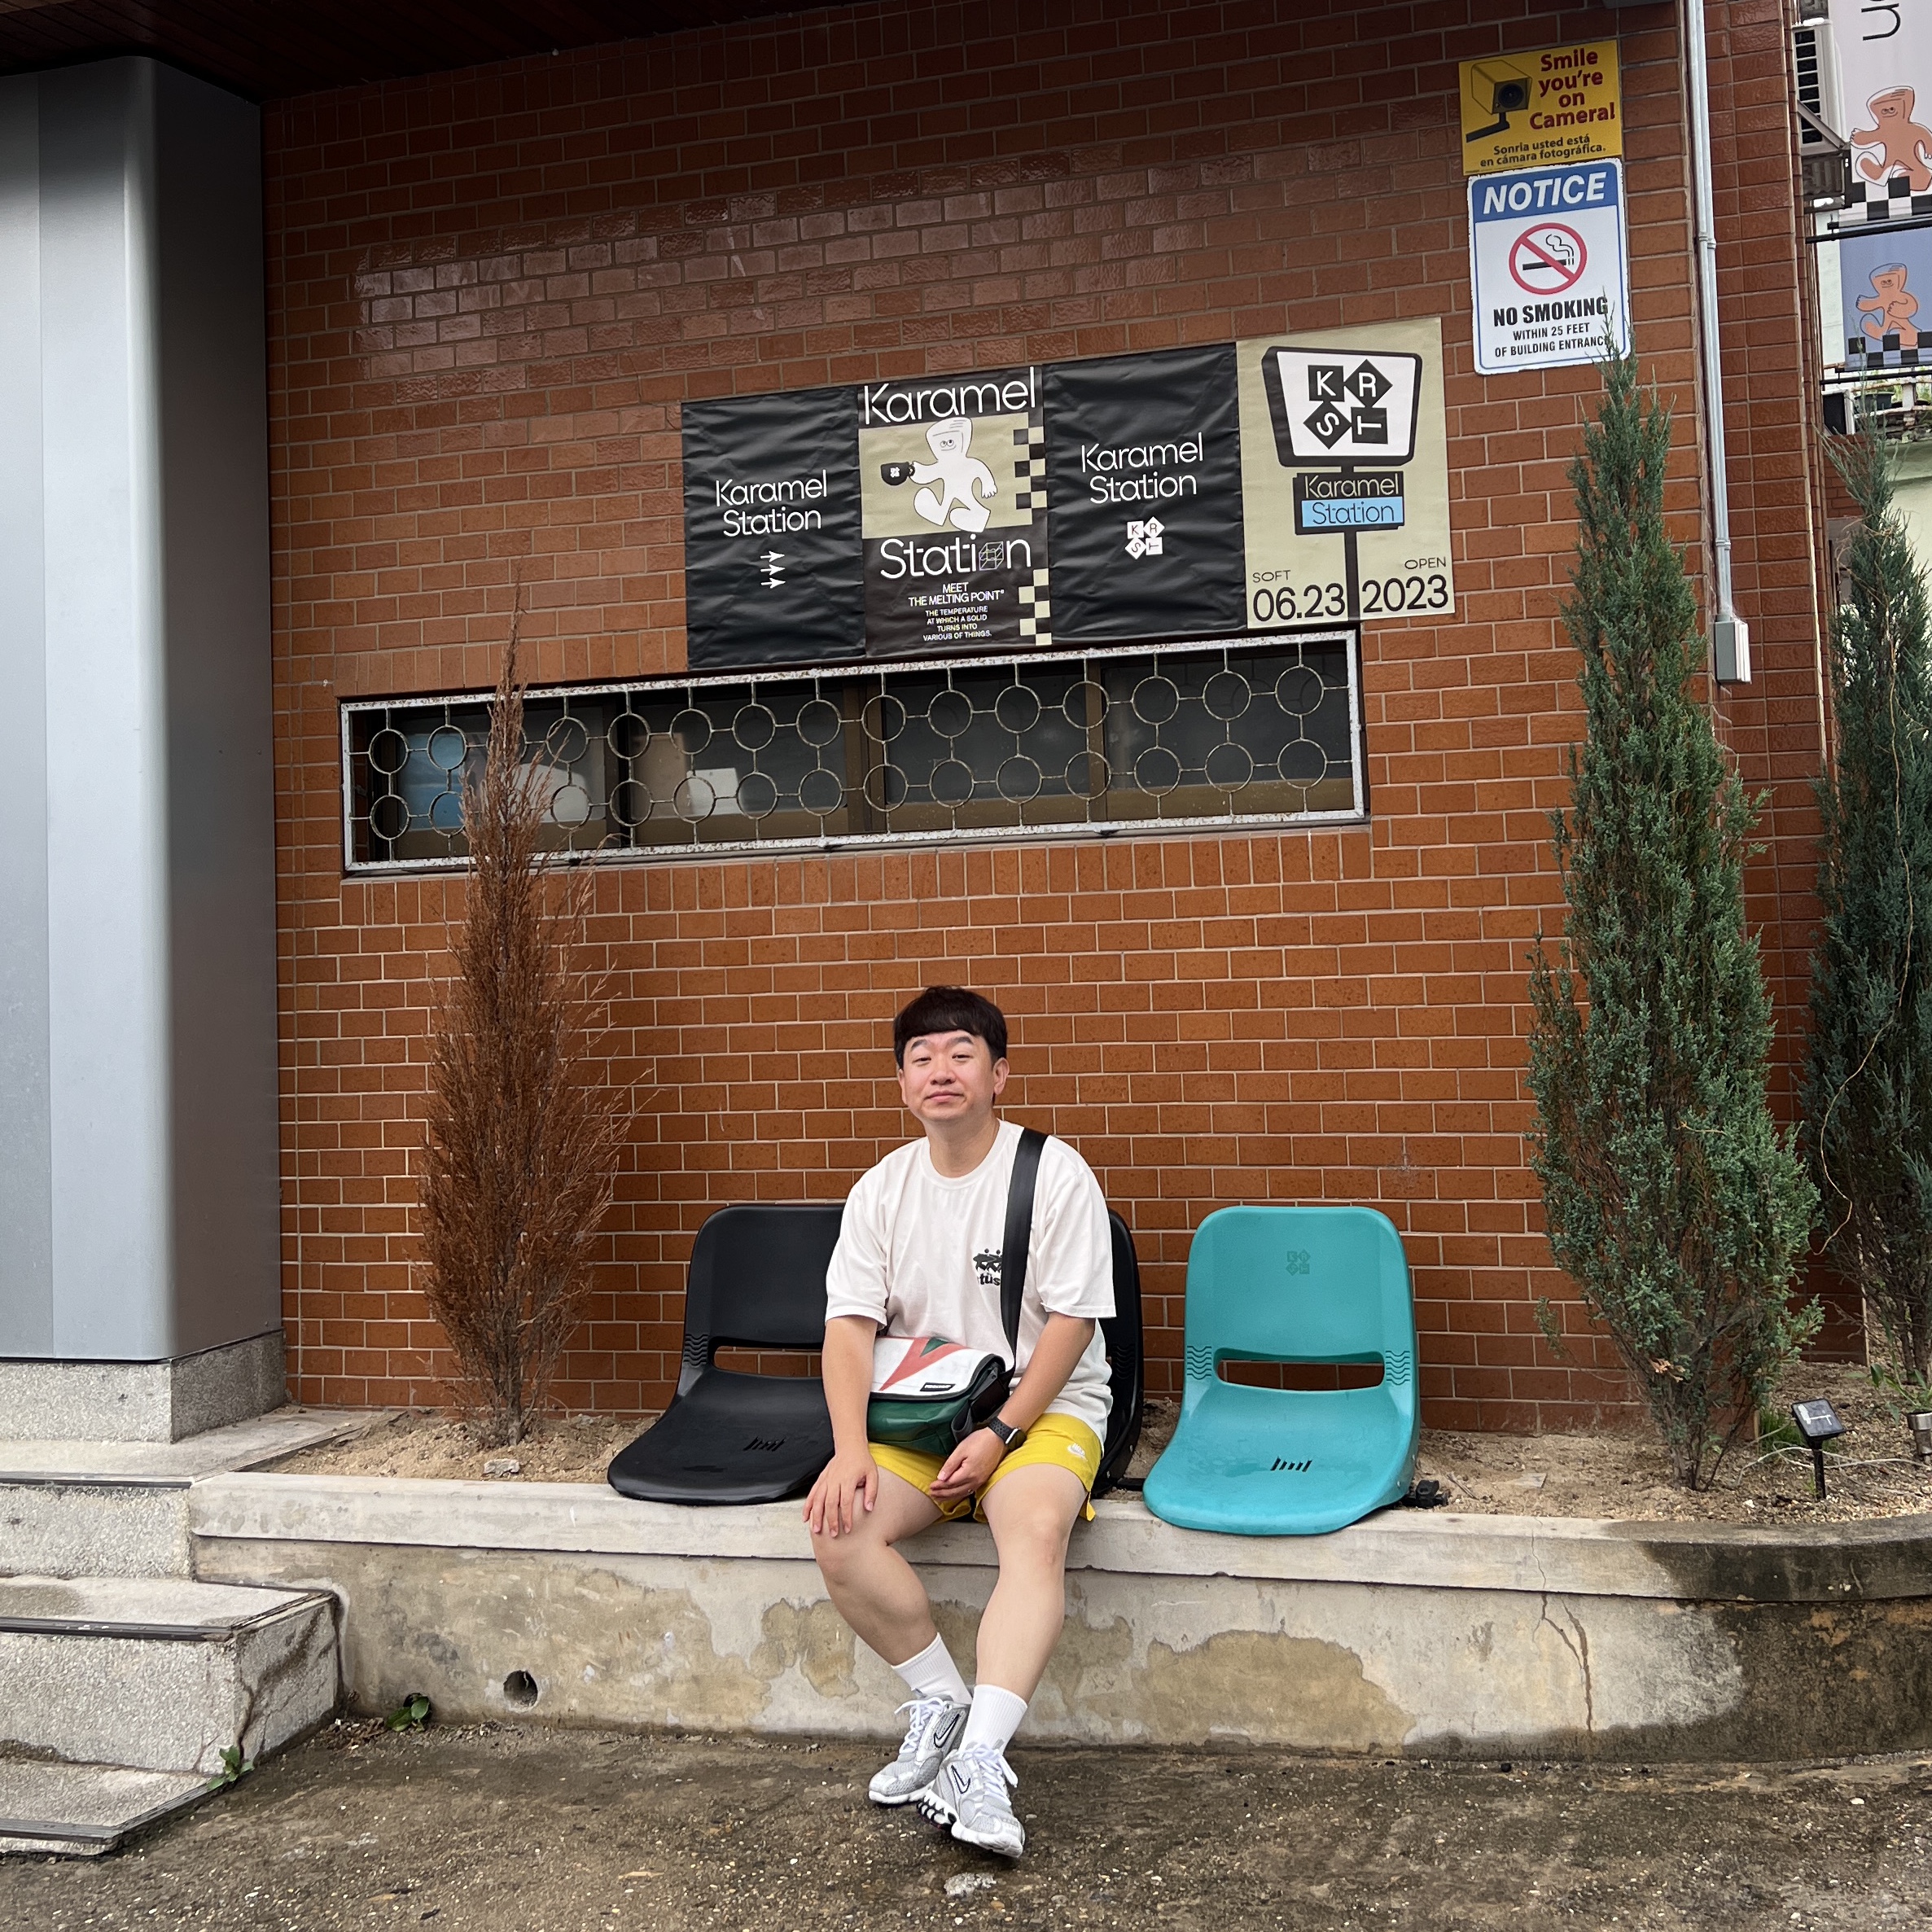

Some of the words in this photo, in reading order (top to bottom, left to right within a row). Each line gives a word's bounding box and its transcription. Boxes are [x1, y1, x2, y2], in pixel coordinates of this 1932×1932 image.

[1540, 47, 1598, 72] Smile
[1538, 70, 1603, 98] you're
[1558, 91, 1585, 107] on
[1532, 137, 1563, 151] usted
[1566, 133, 1590, 146] está
[1480, 157, 1494, 167] en
[1496, 151, 1537, 164] cámara
[1540, 142, 1606, 160] fotográfica.
[1483, 171, 1607, 215] NOTICE
[1493, 307, 1518, 326] NO
[1522, 296, 1609, 324] SMOKING
[1513, 326, 1548, 341] WITHIN
[1551, 326, 1563, 336] 25
[1566, 322, 1590, 335] FEET
[1495, 346, 1508, 357] OF
[1510, 341, 1556, 356] BUILDING
[864, 366, 1036, 425] Karamel
[1081, 432, 1203, 473] Karamel
[716, 469, 828, 507] Karamel
[1090, 471, 1197, 504] Station
[1304, 473, 1400, 498] Karamel
[723, 506, 821, 537] Station
[1312, 502, 1395, 525] Station
[1404, 556, 1447, 570] OPEN
[942, 582, 969, 594] MEET
[1252, 569, 1291, 583] SOFT
[908, 596, 927, 607] THE
[929, 594, 969, 605] MELTING
[1253, 583, 1346, 622] 06.23
[1361, 574, 1449, 613] 2023
[925, 609, 939, 617] THE
[940, 606, 988, 616] TEMPERATURE
[935, 616, 959, 624] WHICH
[966, 614, 988, 622] SOLID
[922, 633, 953, 642] VARIOUS
